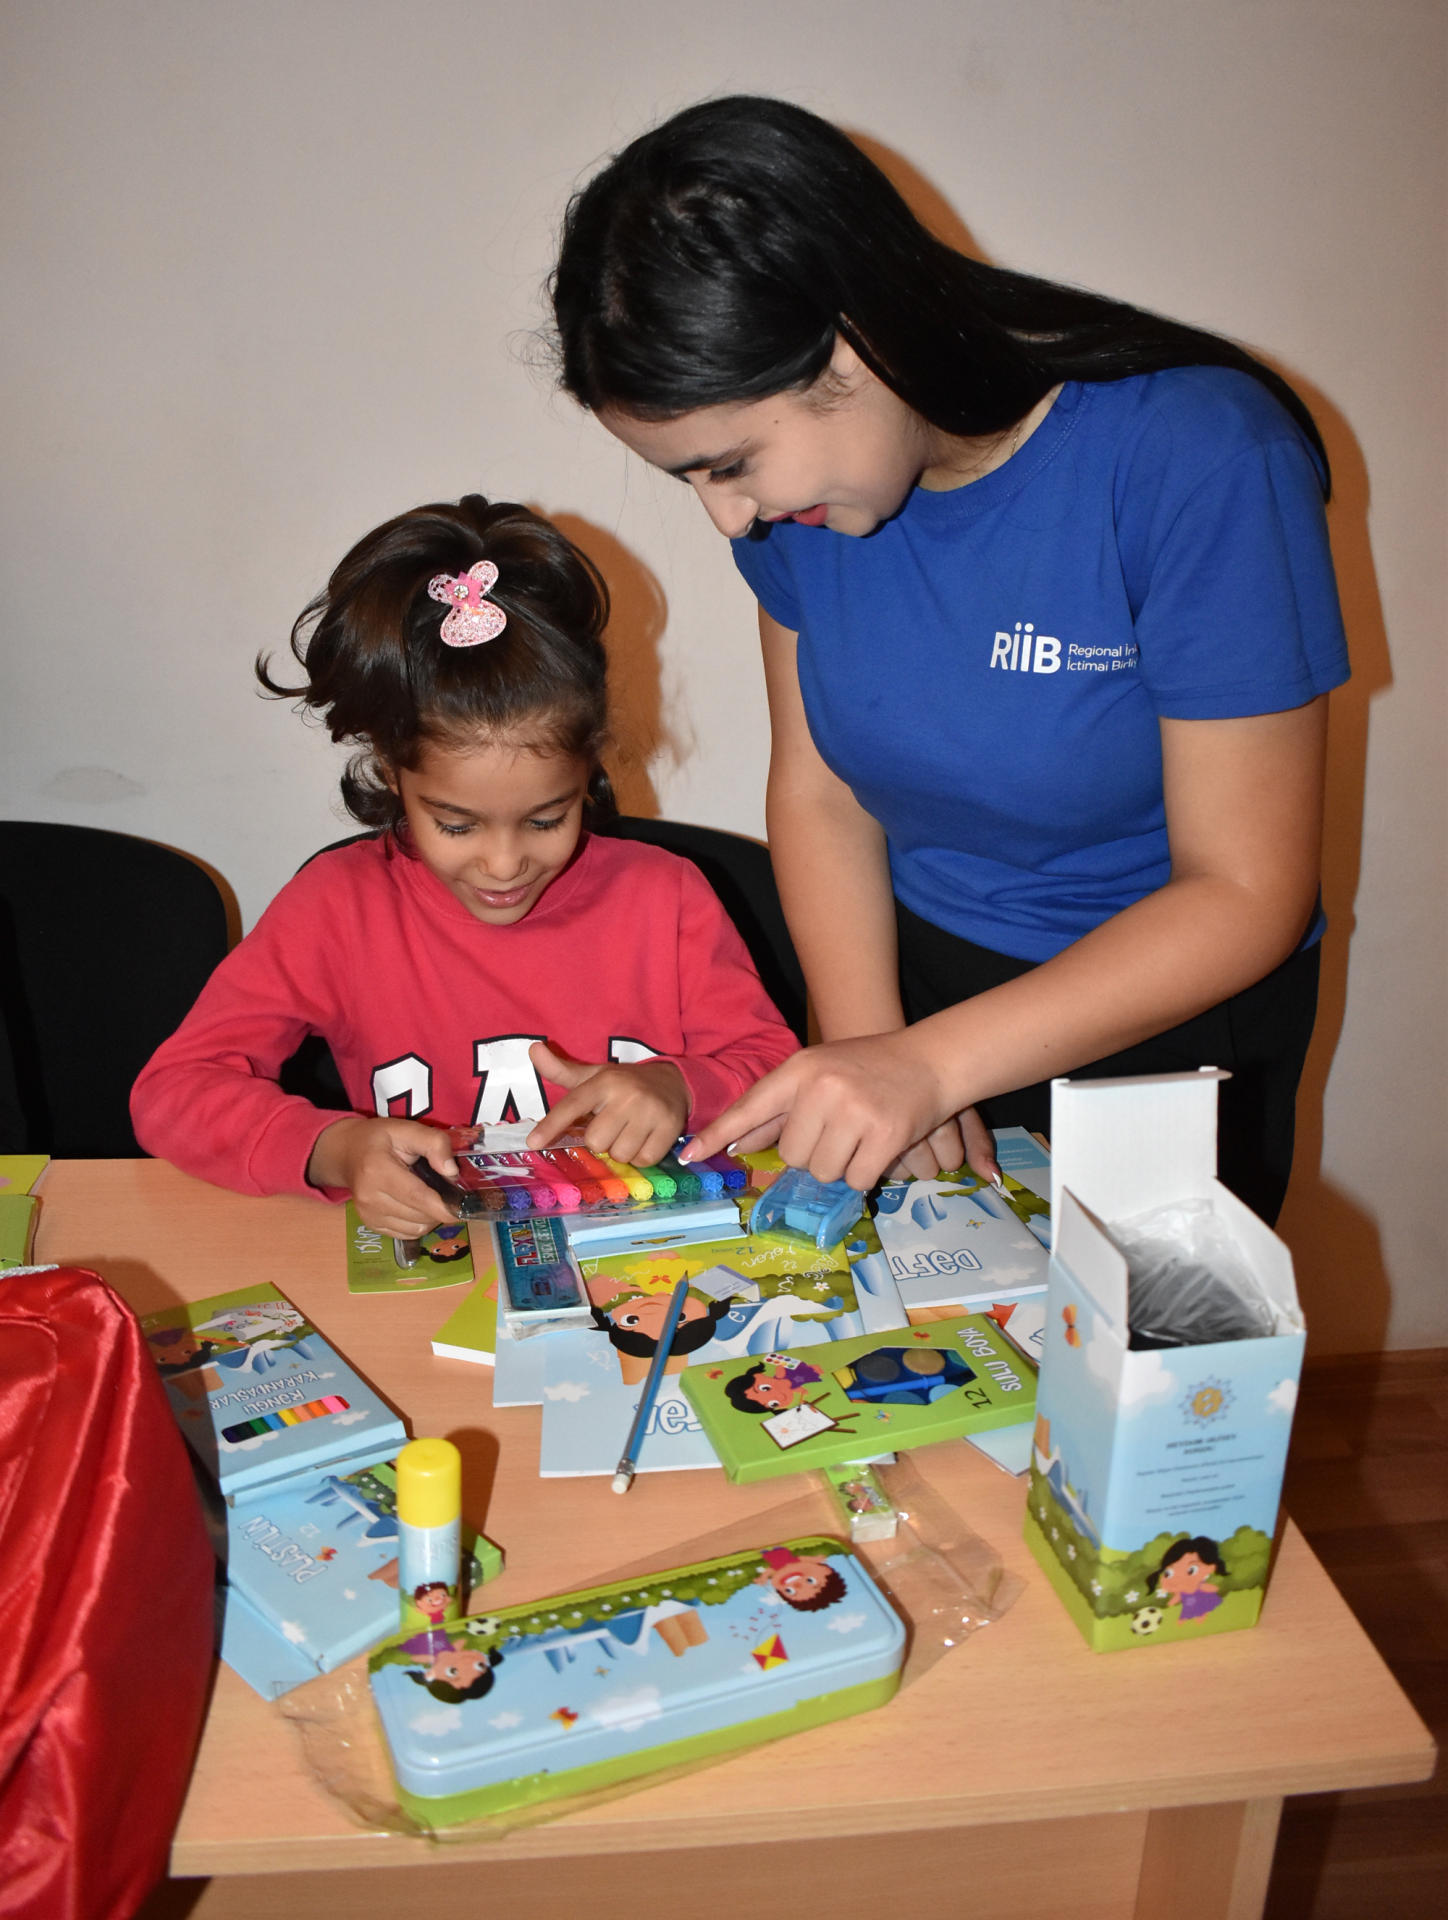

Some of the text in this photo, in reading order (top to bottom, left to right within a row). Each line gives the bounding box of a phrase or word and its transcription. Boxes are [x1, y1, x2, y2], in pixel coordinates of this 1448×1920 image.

[1068, 643, 1122, 658] Regional
[957, 1326, 1023, 1393] SULU BOYA
[964, 1387, 993, 1409] 12
